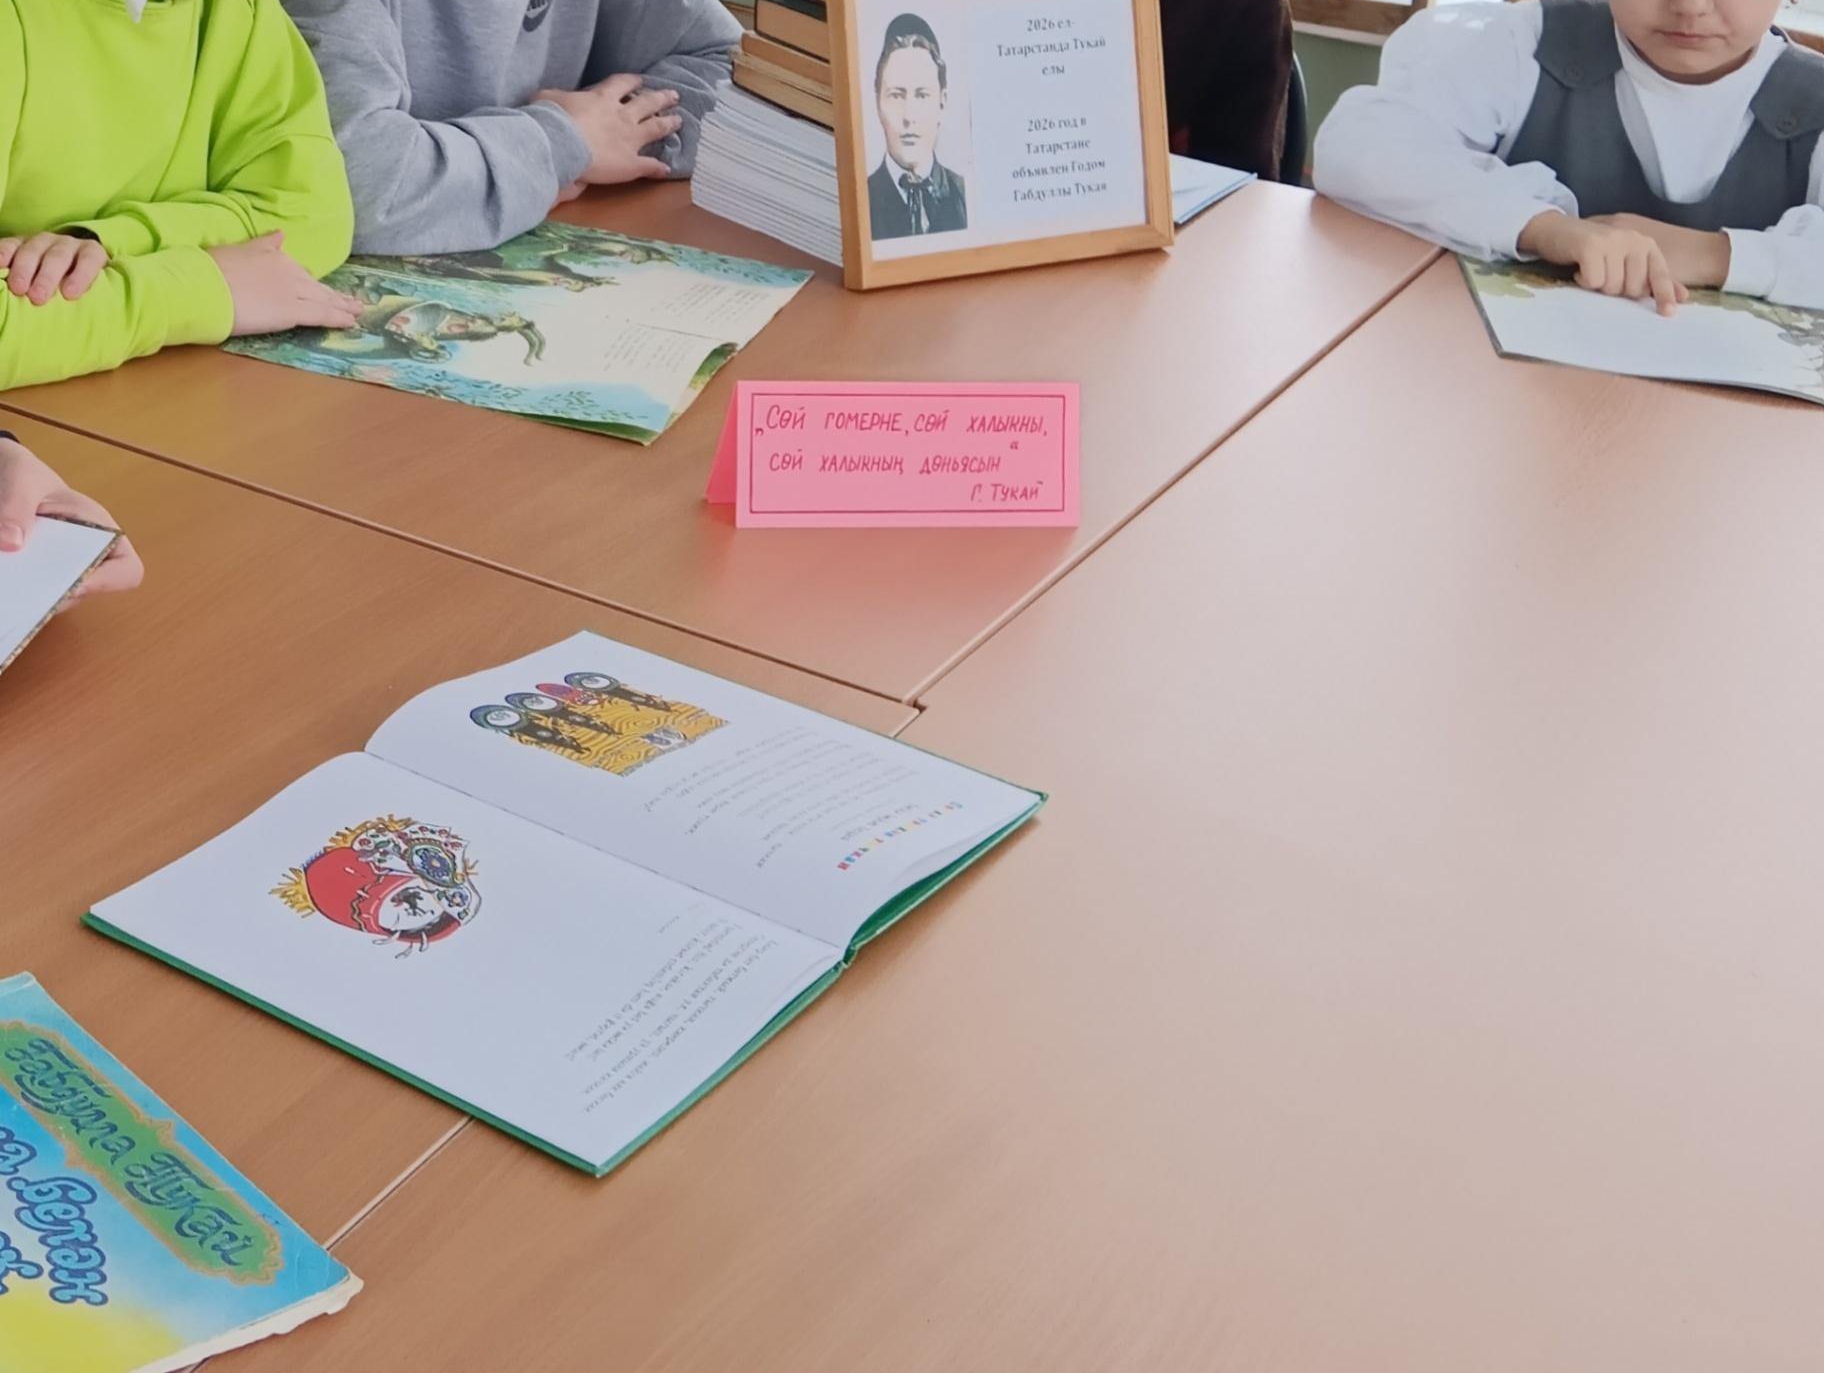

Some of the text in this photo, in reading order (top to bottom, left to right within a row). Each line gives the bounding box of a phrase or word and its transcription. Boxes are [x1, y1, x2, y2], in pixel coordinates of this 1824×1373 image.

[1027, 18, 1055, 32] 2026
[997, 36, 1106, 58] Татарстанда Тукай
[1042, 64, 1066, 76] елы
[1027, 118, 1056, 132] 2026
[1058, 117, 1079, 129] год
[1025, 138, 1091, 155] Татарстане
[1012, 160, 1106, 179] объявлен Годом
[1013, 181, 1107, 204] Габдуллы Тукая
[914, 408, 950, 433] СӨЙ
[769, 448, 803, 472] СӨЙ
[990, 481, 1044, 502] ТУКАЙ
[4, 1037, 254, 1267] Габдулла Тукай
[7, 1176, 109, 1306] белән
